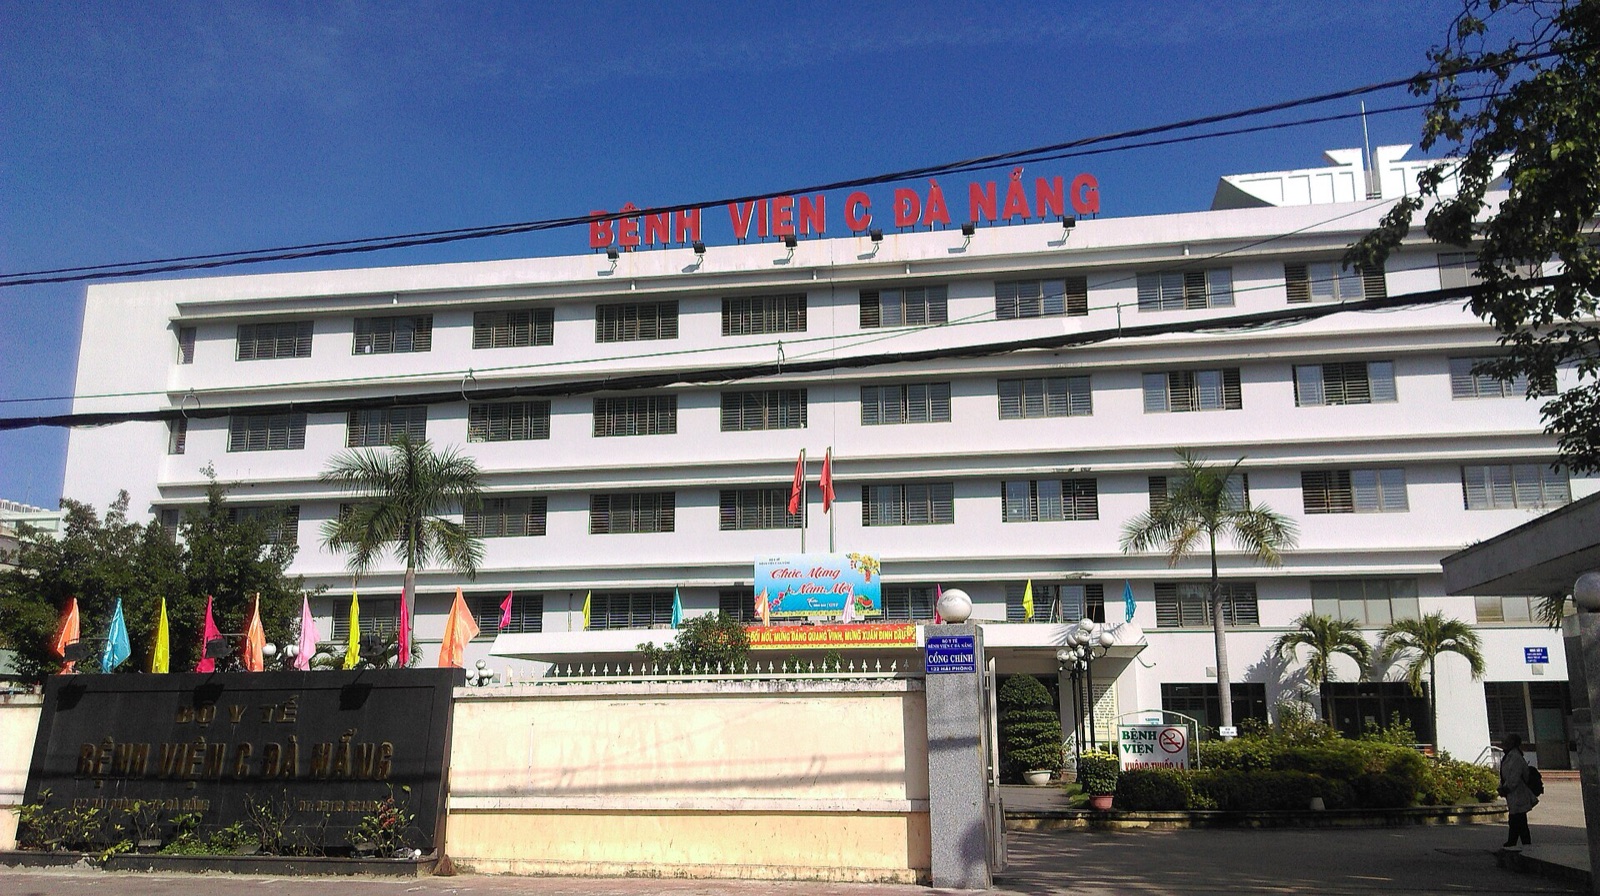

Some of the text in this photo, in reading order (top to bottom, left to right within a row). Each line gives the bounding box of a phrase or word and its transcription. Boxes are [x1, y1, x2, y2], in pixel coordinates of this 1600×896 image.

[844, 191, 874, 232] C
[894, 179, 952, 228] ĐÀ
[950, 652, 974, 663] CHÍNH
[1122, 728, 1157, 742] BỆNH
[1122, 742, 1154, 756] VIỆN
[158, 736, 226, 789] VIỆN
[233, 742, 252, 779] C
[261, 735, 300, 780] ĐÀ
